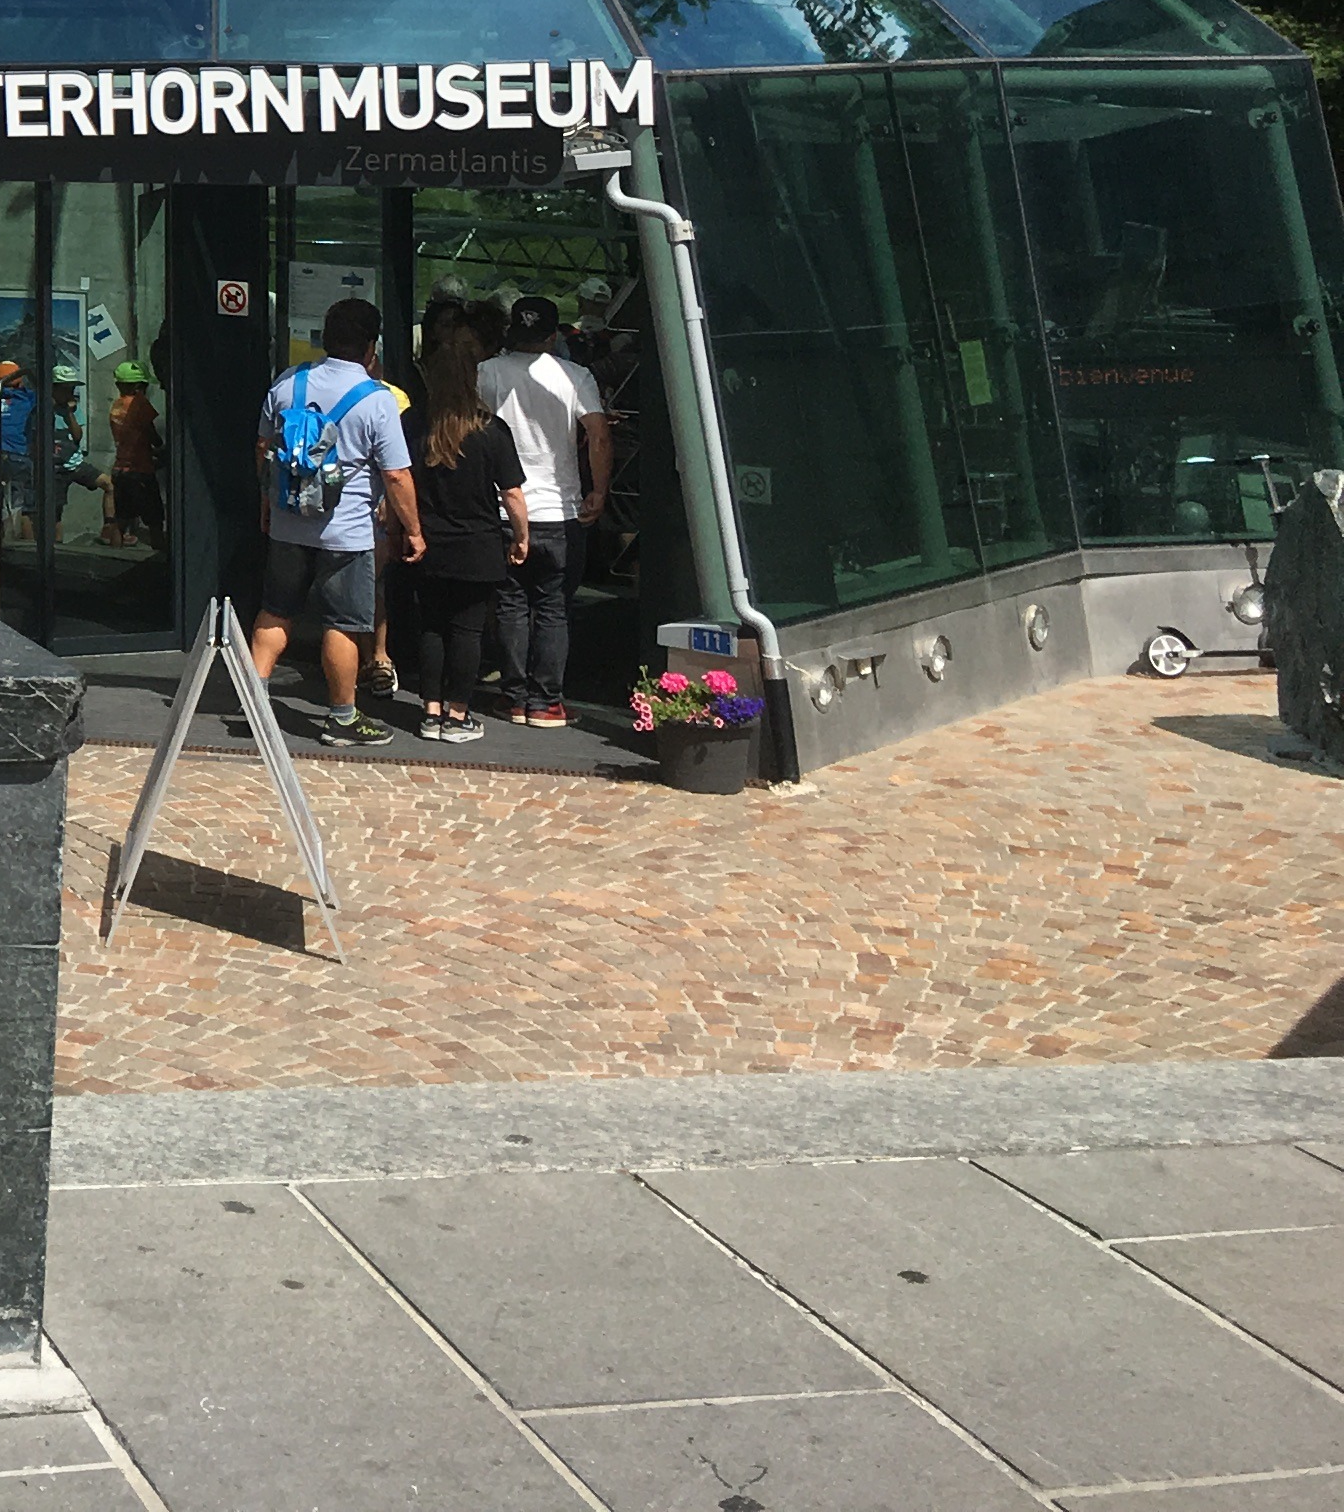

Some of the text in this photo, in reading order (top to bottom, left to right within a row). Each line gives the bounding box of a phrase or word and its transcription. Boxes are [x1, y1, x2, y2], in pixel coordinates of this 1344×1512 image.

[318, 57, 655, 132] MUSEUM
[345, 145, 548, 174] Zermatlantis
[1058, 364, 1194, 386] bienvenue
[703, 631, 721, 650] 11
